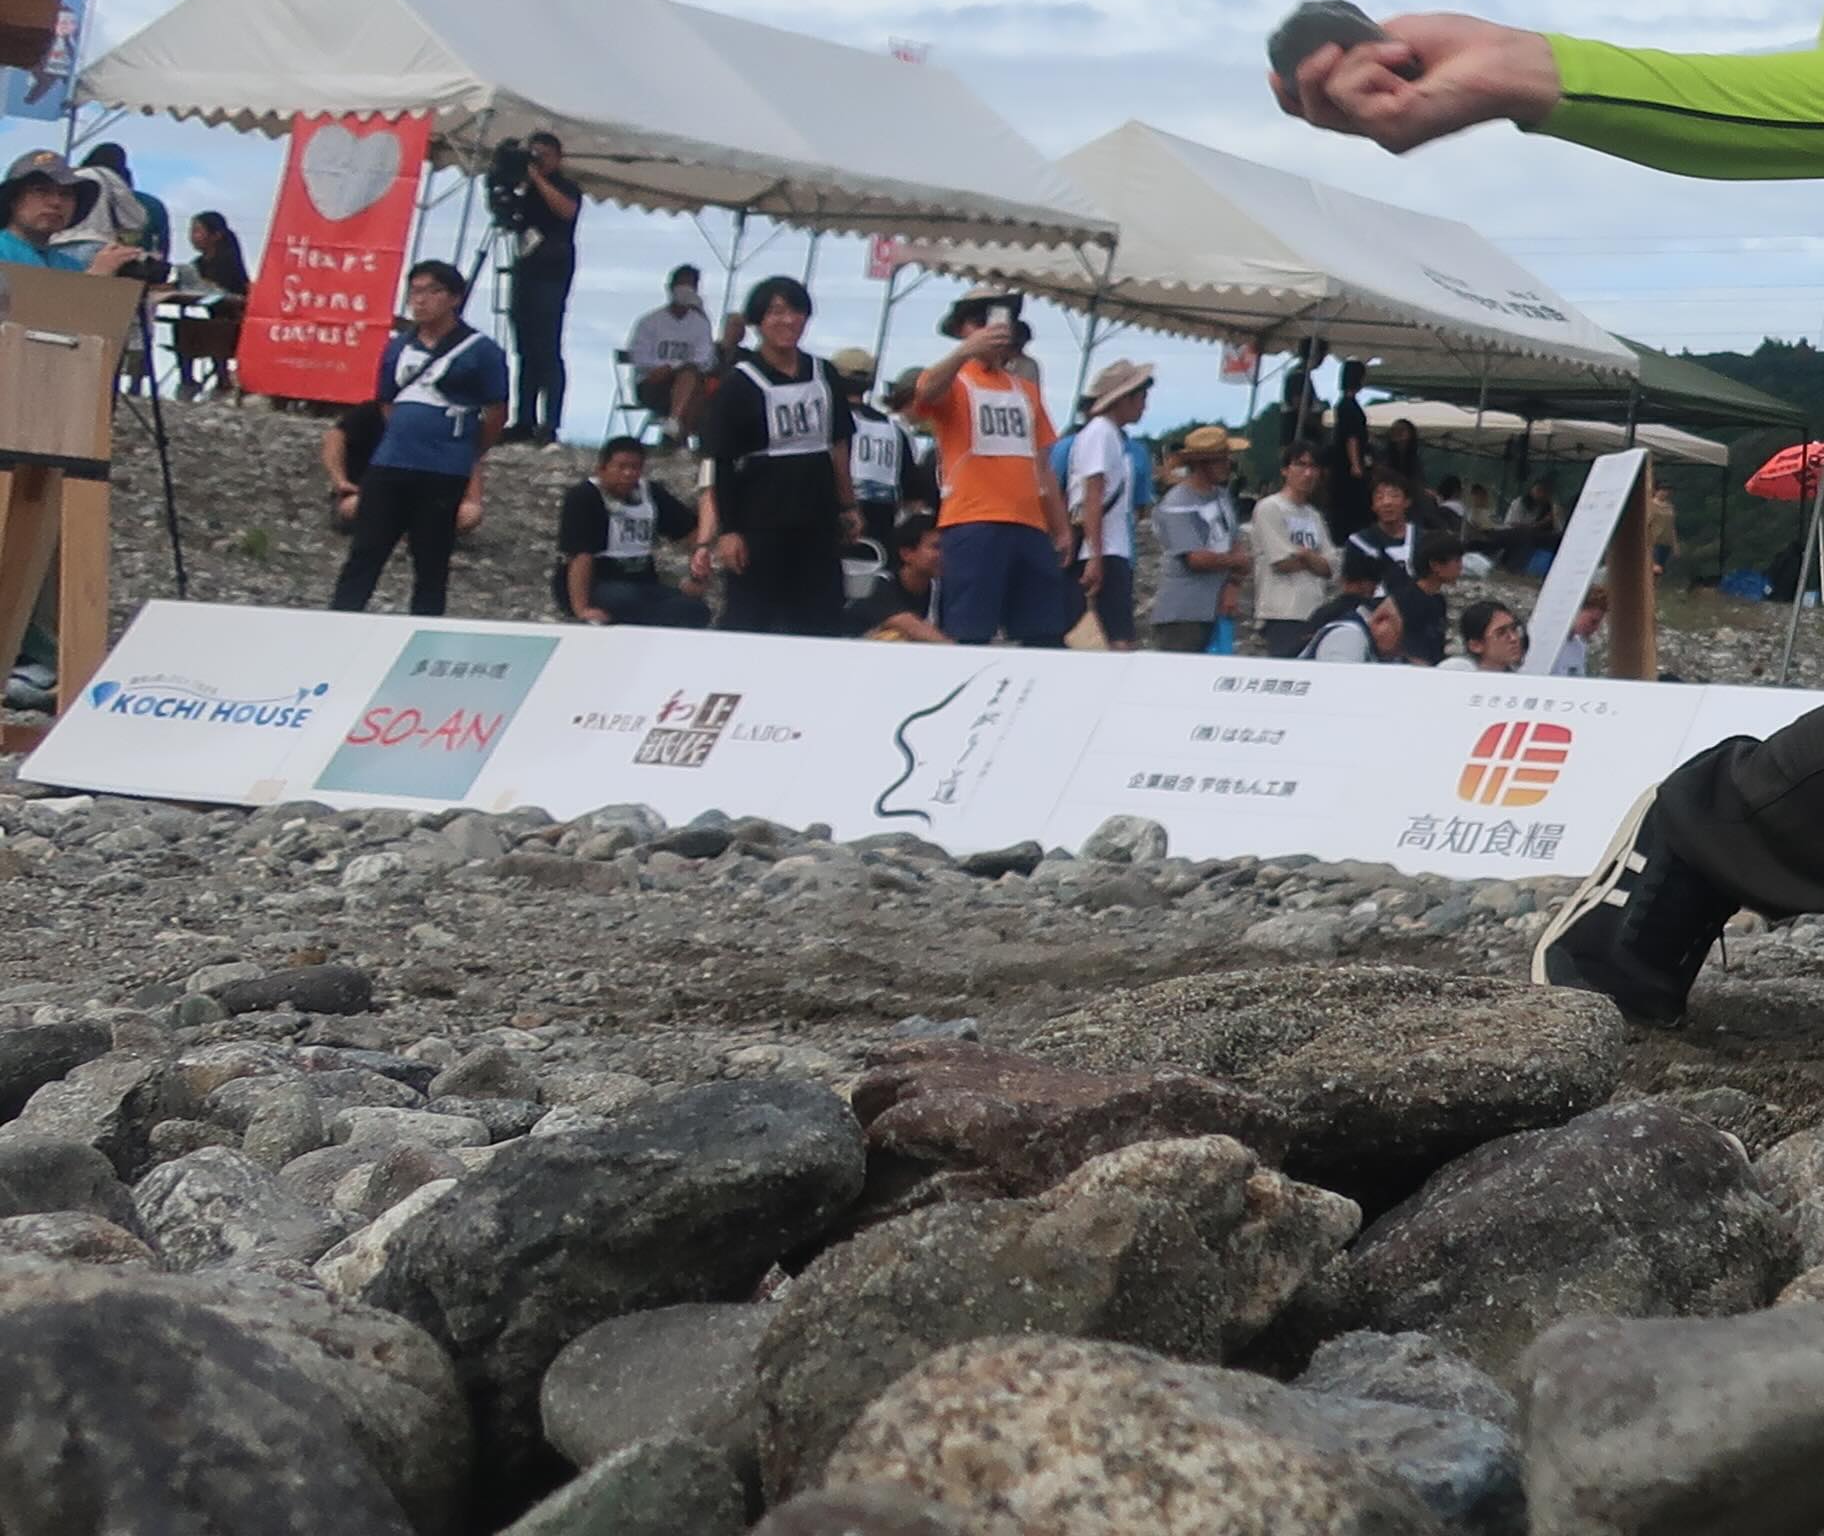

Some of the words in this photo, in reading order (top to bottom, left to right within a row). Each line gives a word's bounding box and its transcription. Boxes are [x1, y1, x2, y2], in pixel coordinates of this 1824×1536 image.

[287, 235, 378, 272] Heart
[281, 275, 368, 313] Stone
[111, 693, 205, 720] KOCHI
[208, 702, 312, 728] HOUSE
[583, 713, 645, 732] PAPER
[346, 707, 505, 752] SO-AN
[1397, 813, 1566, 861] 高知食糧
